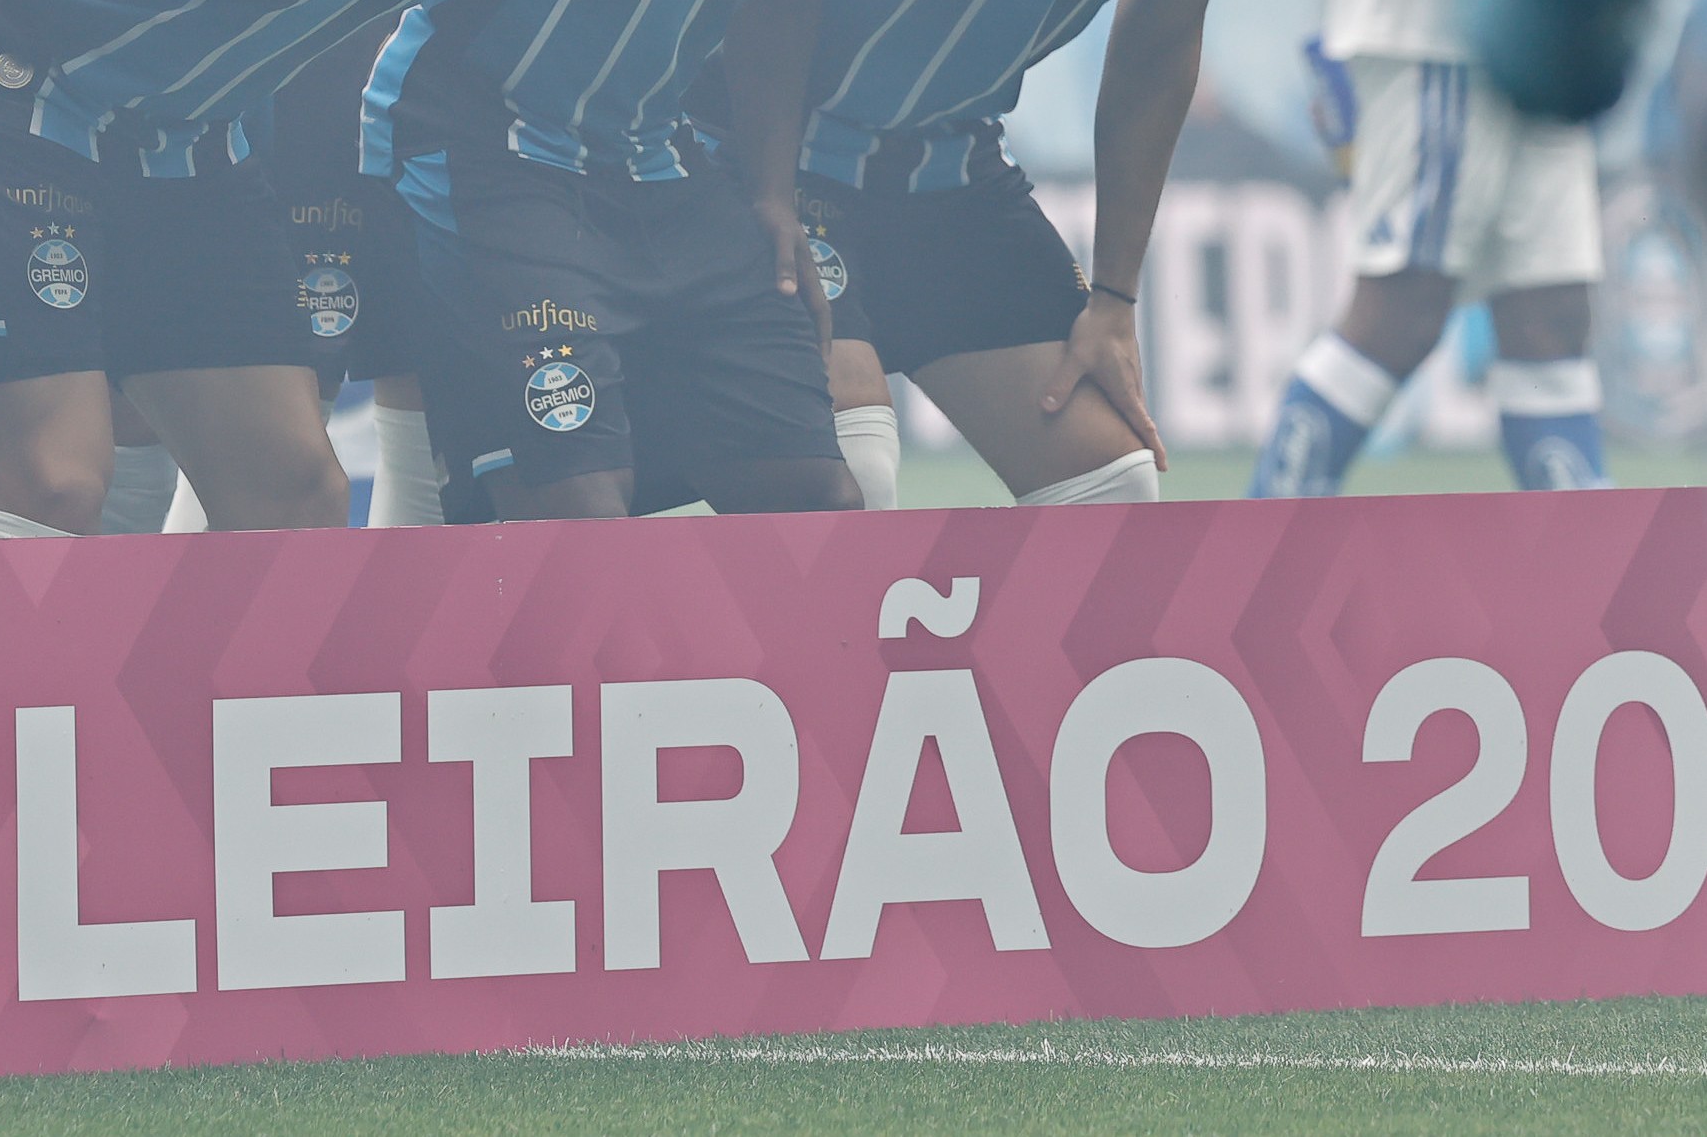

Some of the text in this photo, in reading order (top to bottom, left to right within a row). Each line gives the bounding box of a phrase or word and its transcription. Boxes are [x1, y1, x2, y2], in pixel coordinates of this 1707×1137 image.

[30, 264, 86, 283] GRÊMIO
[306, 292, 356, 310] RÊMIO
[501, 299, 598, 332] unifique
[530, 384, 591, 412] GRÊMIO
